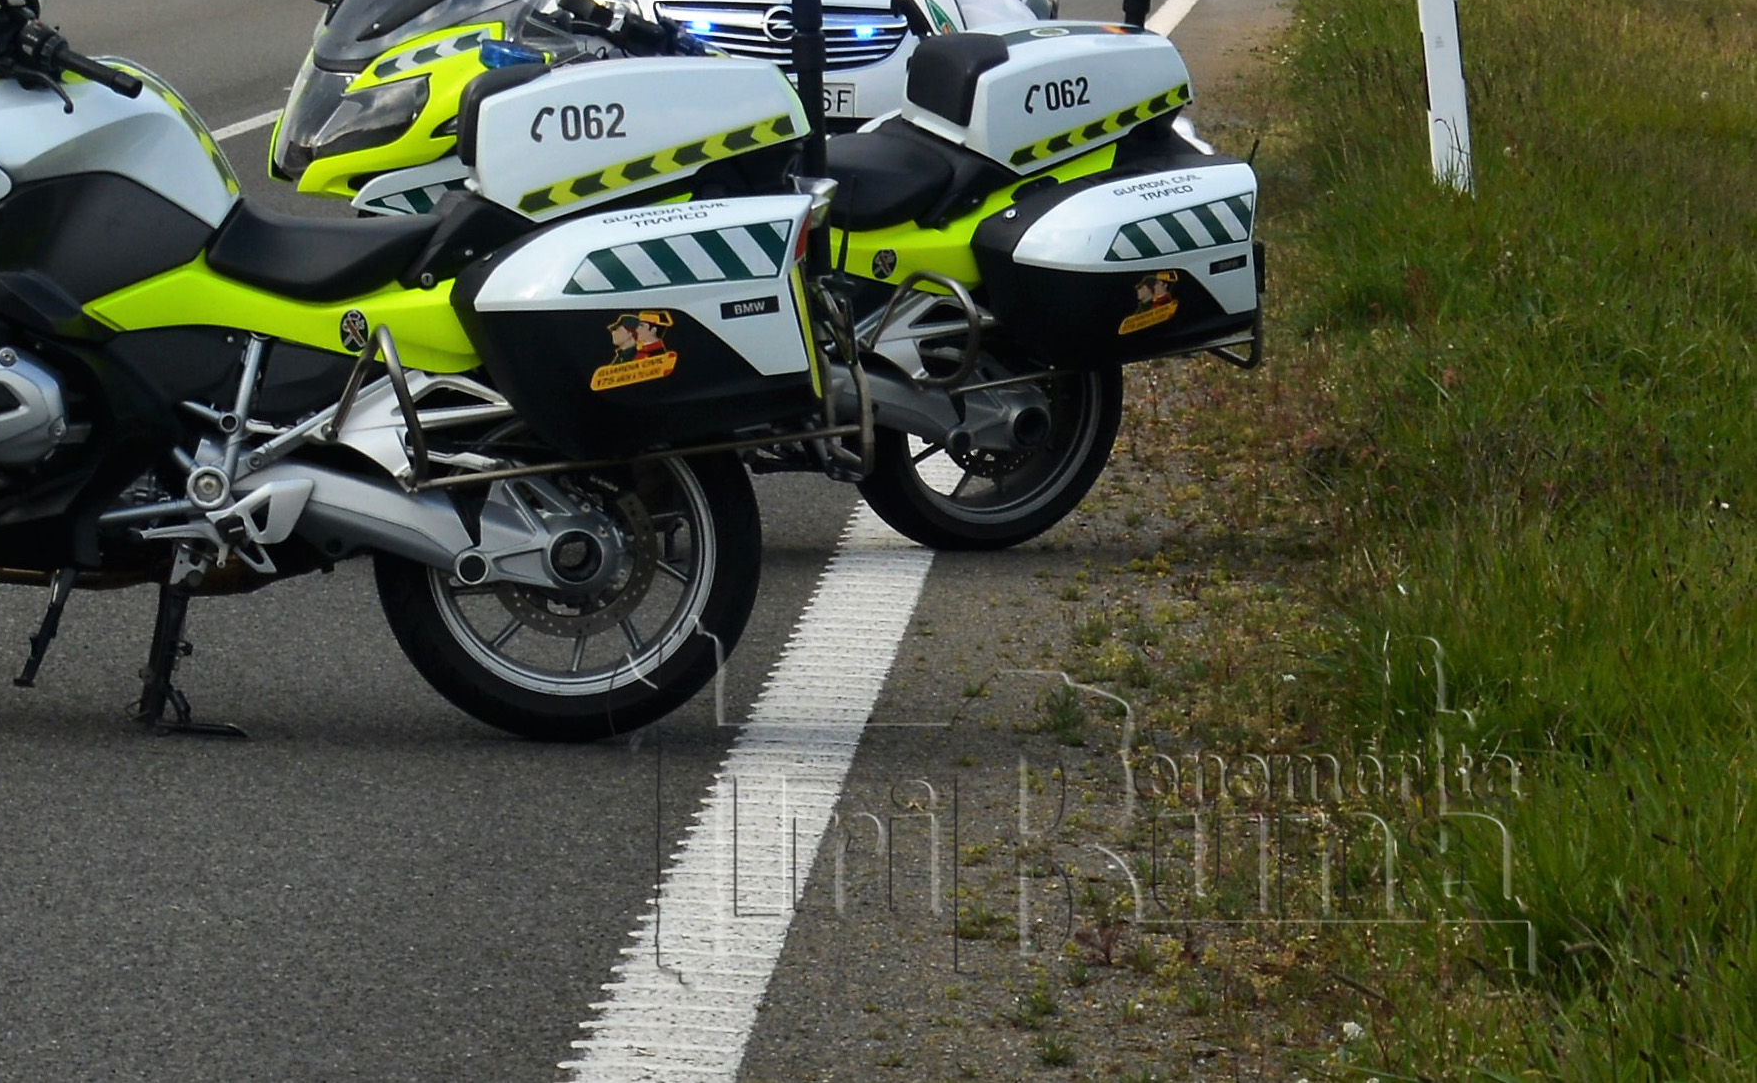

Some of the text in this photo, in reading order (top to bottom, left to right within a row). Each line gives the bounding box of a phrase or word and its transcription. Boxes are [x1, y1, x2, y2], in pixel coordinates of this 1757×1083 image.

[1045, 76, 1091, 112] 062
[560, 102, 627, 142] 062
[1113, 179, 1170, 196] GUARDIA
[1139, 185, 1193, 201] TRAFICO
[602, 201, 731, 225] GUARDIA CIVIL
[631, 211, 708, 228] TRAFICO
[733, 300, 766, 315] BMW
